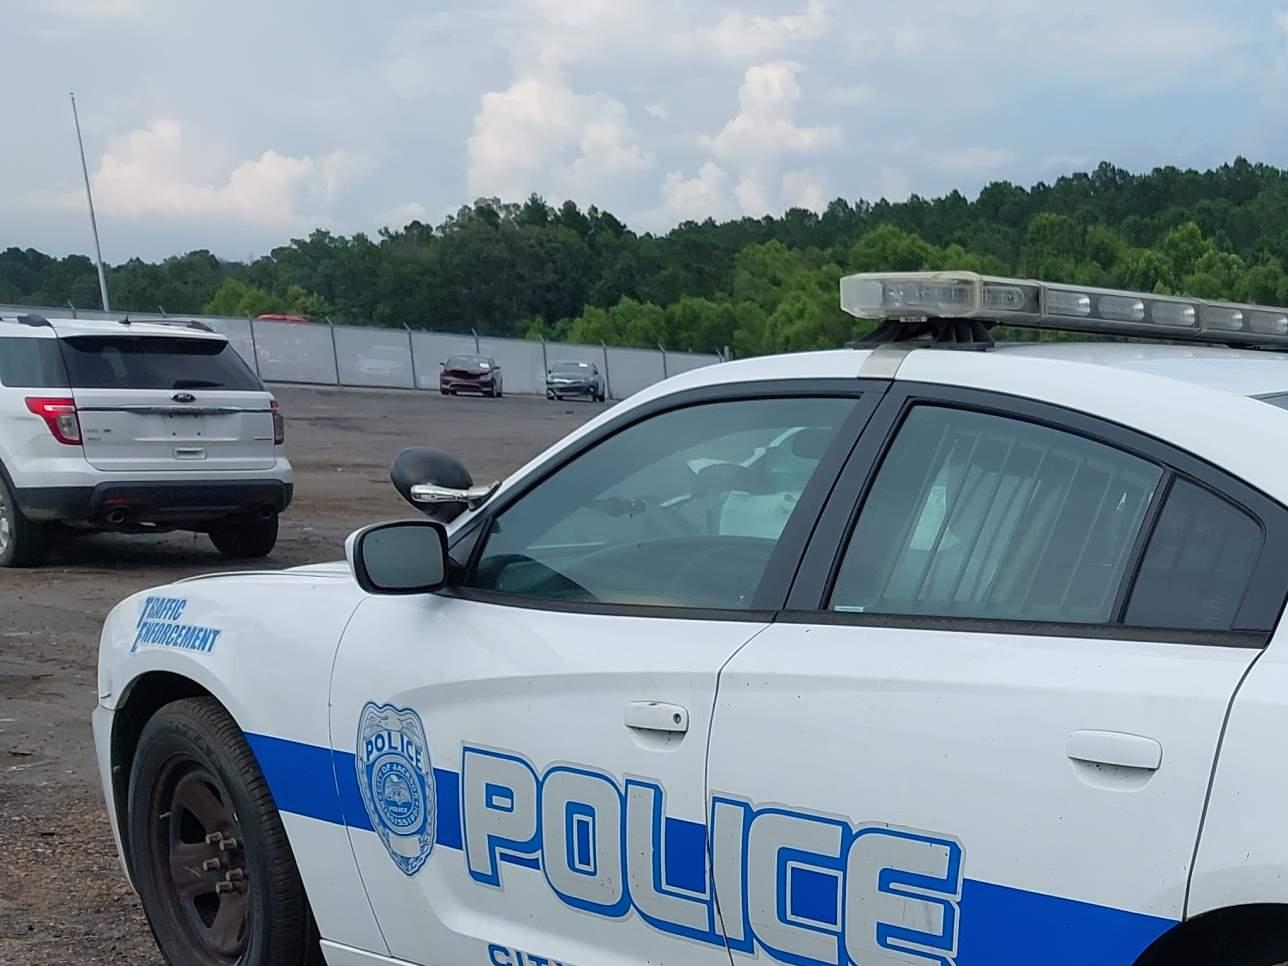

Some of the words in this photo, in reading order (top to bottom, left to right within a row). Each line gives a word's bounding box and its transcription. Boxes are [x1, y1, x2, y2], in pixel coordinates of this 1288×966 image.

[136, 596, 188, 629] TRAFFIC
[130, 621, 221, 653] ENFORCEMENT
[365, 731, 422, 771] POLICE
